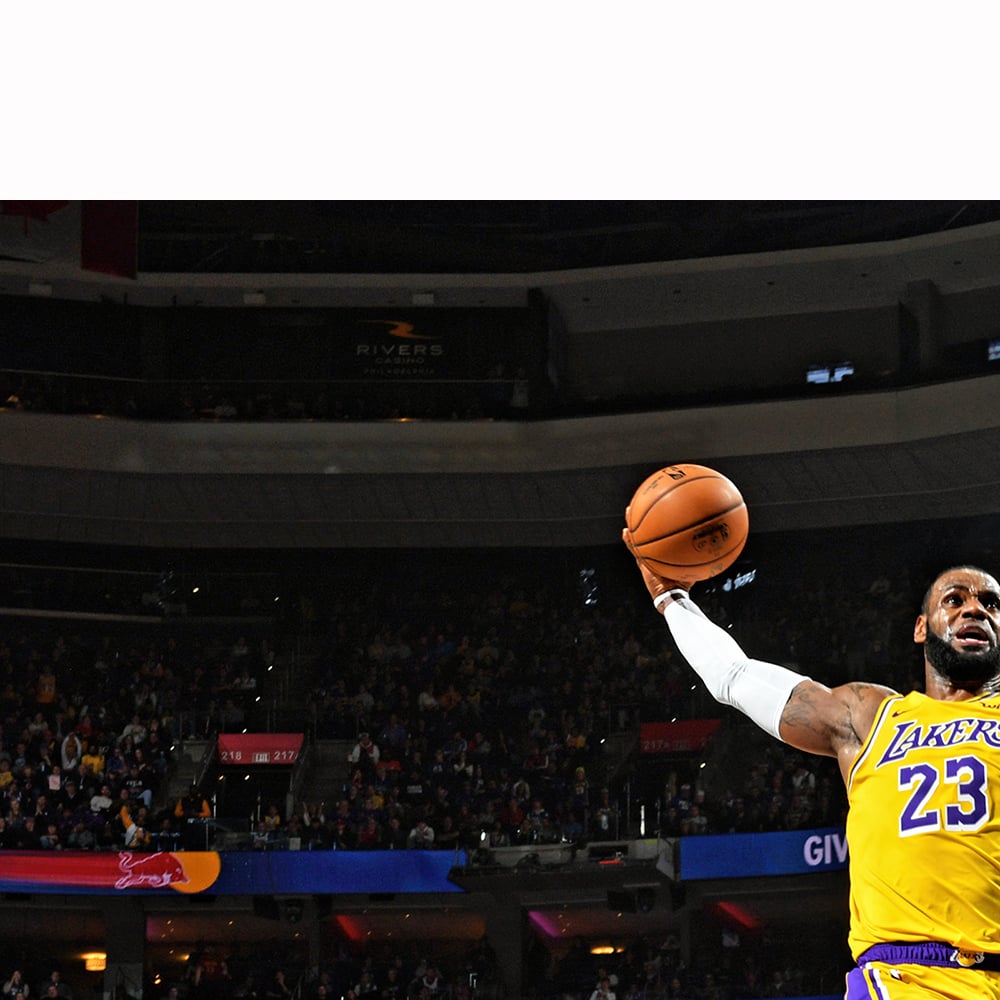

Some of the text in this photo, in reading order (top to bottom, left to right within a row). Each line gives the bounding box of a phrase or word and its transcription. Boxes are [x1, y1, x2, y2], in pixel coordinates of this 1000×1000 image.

[356, 345, 443, 355] RIVERS
[221, 751, 242, 760] 218
[898, 754, 990, 838] 23
[803, 832, 849, 867] GIV
